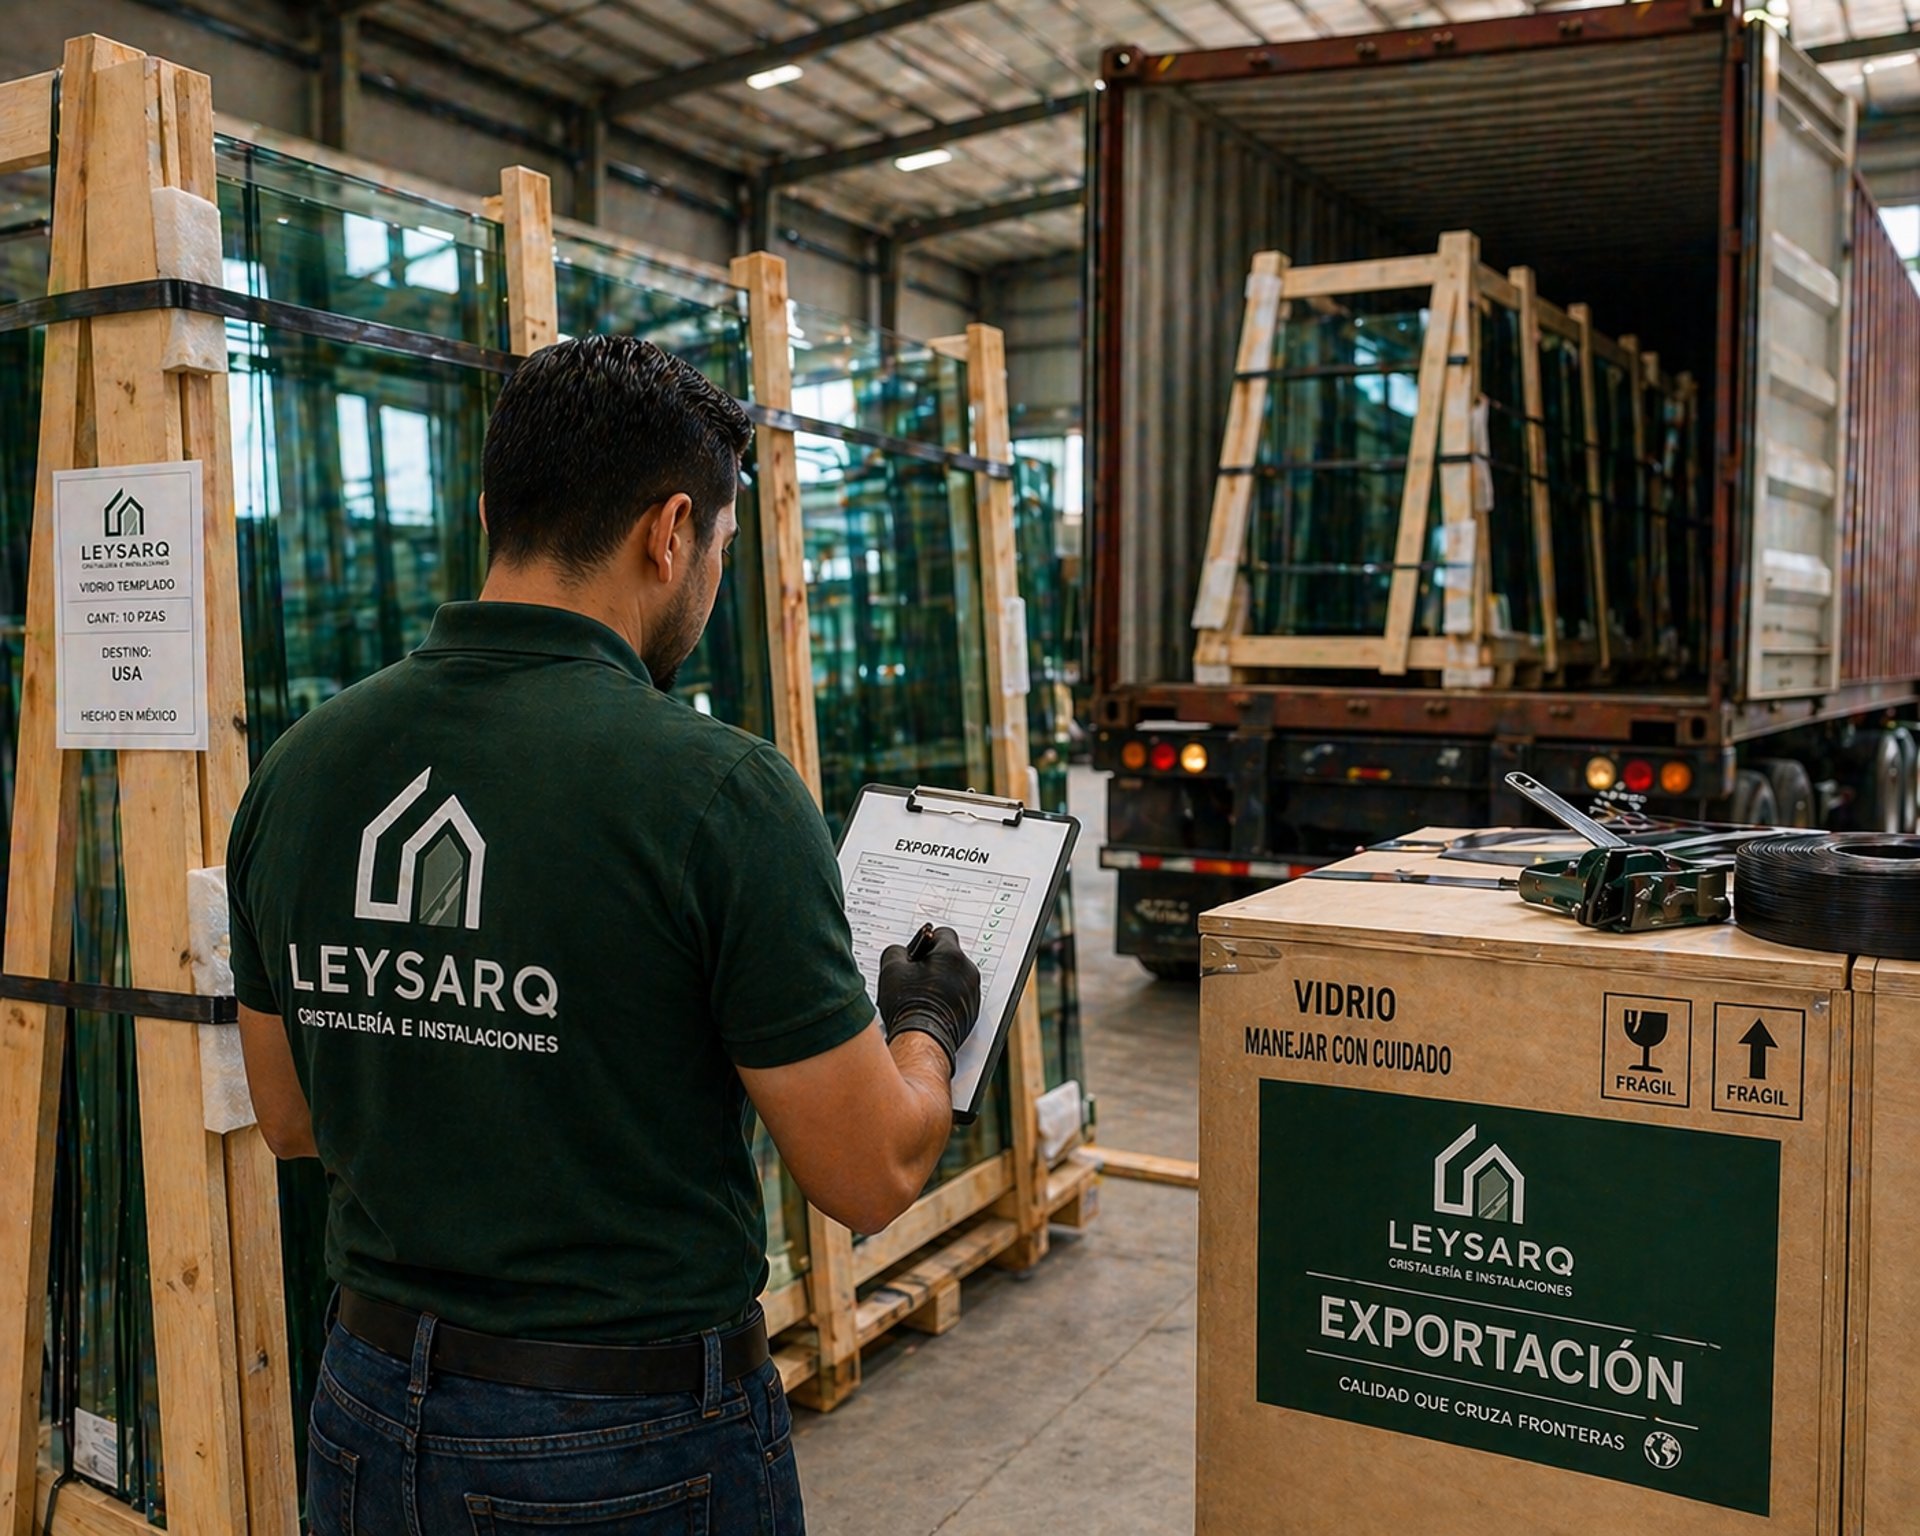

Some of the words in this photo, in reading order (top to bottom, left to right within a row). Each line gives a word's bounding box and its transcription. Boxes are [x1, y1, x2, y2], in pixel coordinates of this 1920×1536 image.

[81, 541, 170, 560] LEYSARQ
[79, 581, 115, 593] VIDRIO
[117, 578, 175, 591] TEMPLADO
[86, 612, 119, 624] CANT:
[122, 611, 135, 623] 10
[137, 610, 166, 622] PZAS
[101, 646, 151, 658] DESTINO:
[111, 666, 142, 681] USA
[81, 710, 117, 722] HECHO
[119, 711, 134, 721] EN
[135, 707, 177, 722] MÉXICO
[894, 838, 990, 865] EXPORTACIÓN
[288, 943, 559, 1019] LEYSARQ
[1293, 979, 1396, 1022] VIDRIO
[297, 1007, 396, 1035] CRISTALERÍA
[401, 1018, 413, 1036] E
[418, 1020, 559, 1054] INSTALACIONES
[1245, 1026, 1328, 1062] MANEJAR
[1332, 1035, 1368, 1066] CON
[1372, 1039, 1453, 1075] CUIDADO
[1389, 1220, 1575, 1277] LEYSARQ
[1388, 1257, 1462, 1280] CRISTALERÍA
[1465, 1269, 1473, 1281] E
[1475, 1271, 1573, 1297] INSTALACIONES
[1320, 1295, 1684, 1406] EXPORTACIÓN
[1338, 1376, 1410, 1404] CALIDAD
[1414, 1391, 1450, 1414] QUE
[1454, 1401, 1513, 1428] CRUZA
[1518, 1414, 1626, 1452] FRONTERAS
